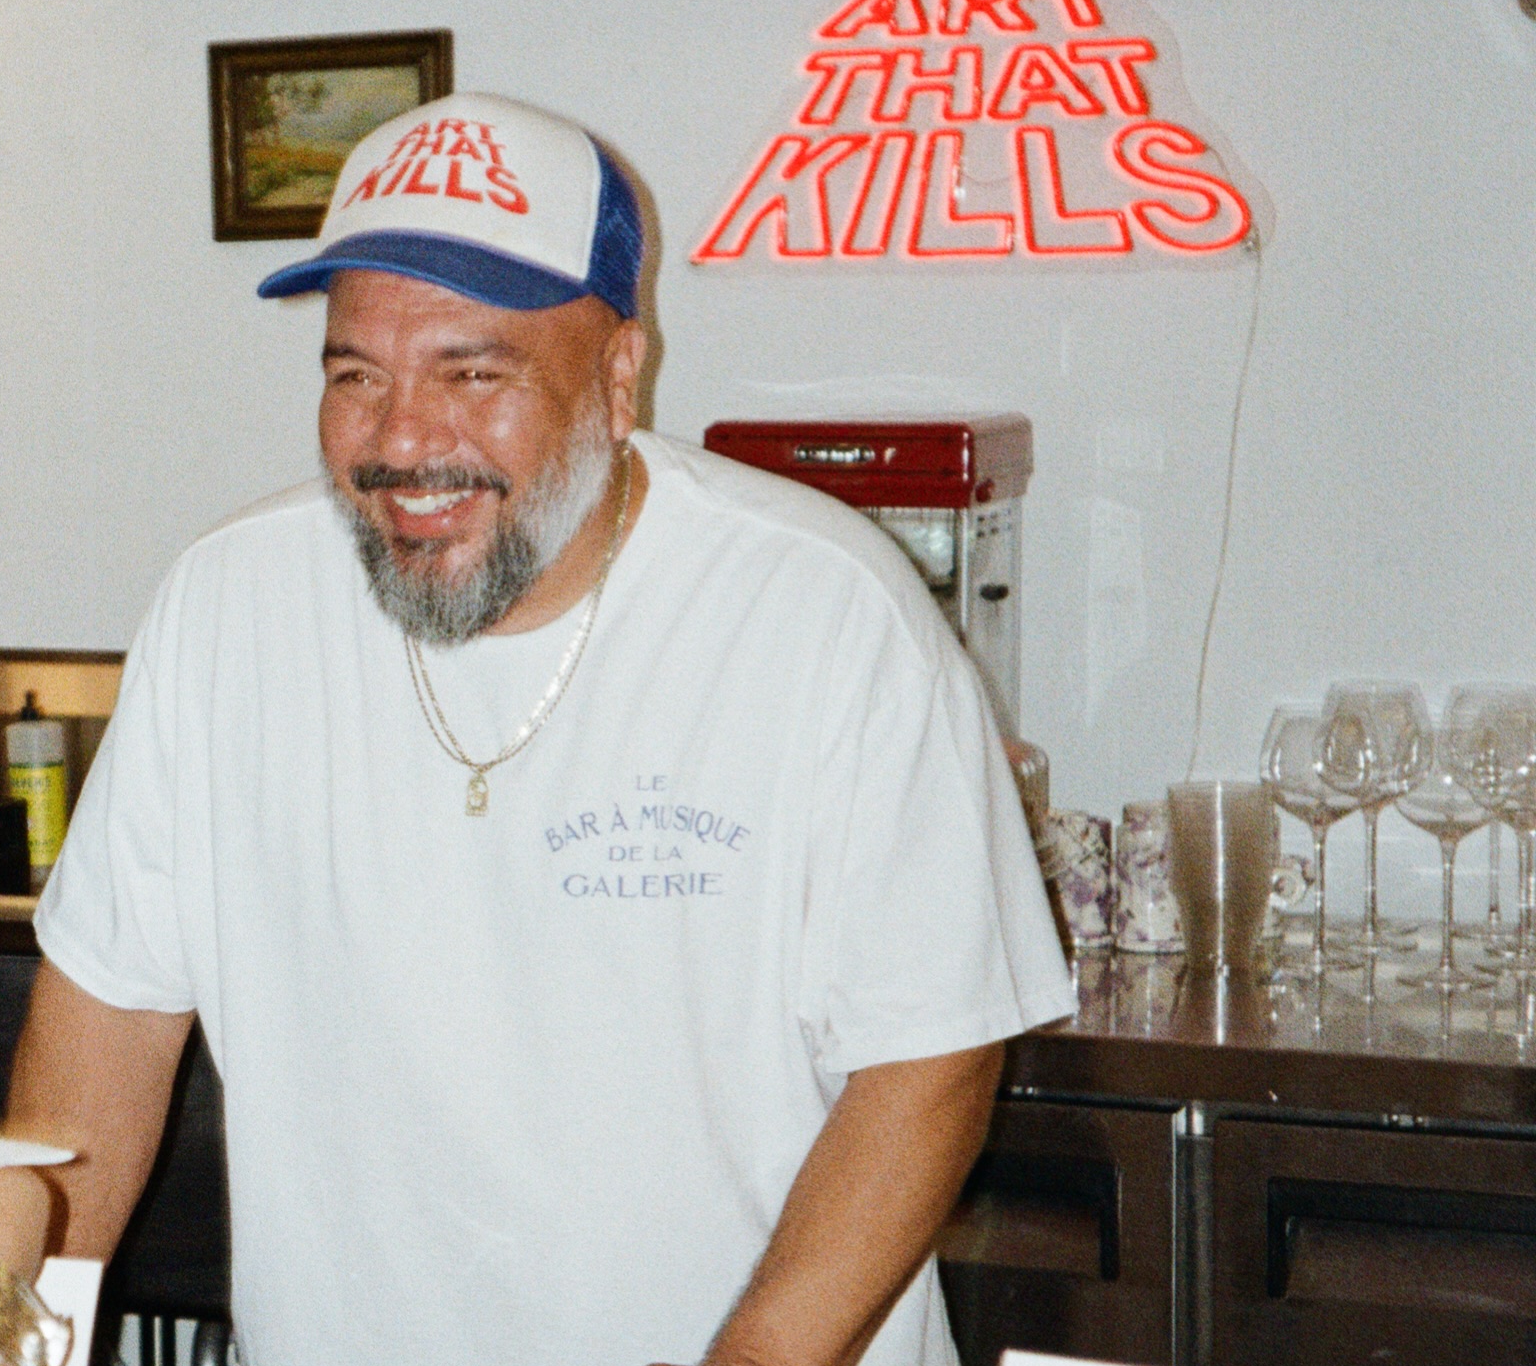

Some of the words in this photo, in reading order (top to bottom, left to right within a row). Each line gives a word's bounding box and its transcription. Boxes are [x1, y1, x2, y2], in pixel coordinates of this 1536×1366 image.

[798, 38, 1157, 125] THAT
[403, 117, 497, 141] ART
[388, 135, 505, 166] THAT
[342, 158, 529, 215] KILLS
[689, 120, 1253, 265] KILLS
[635, 774, 668, 792] LE
[544, 811, 601, 853] BAR
[610, 802, 630, 833] À
[638, 804, 751, 852] MUSIQUE
[608, 845, 644, 863] DE
[653, 845, 683, 862] LA
[563, 872, 724, 899] GALERIE
